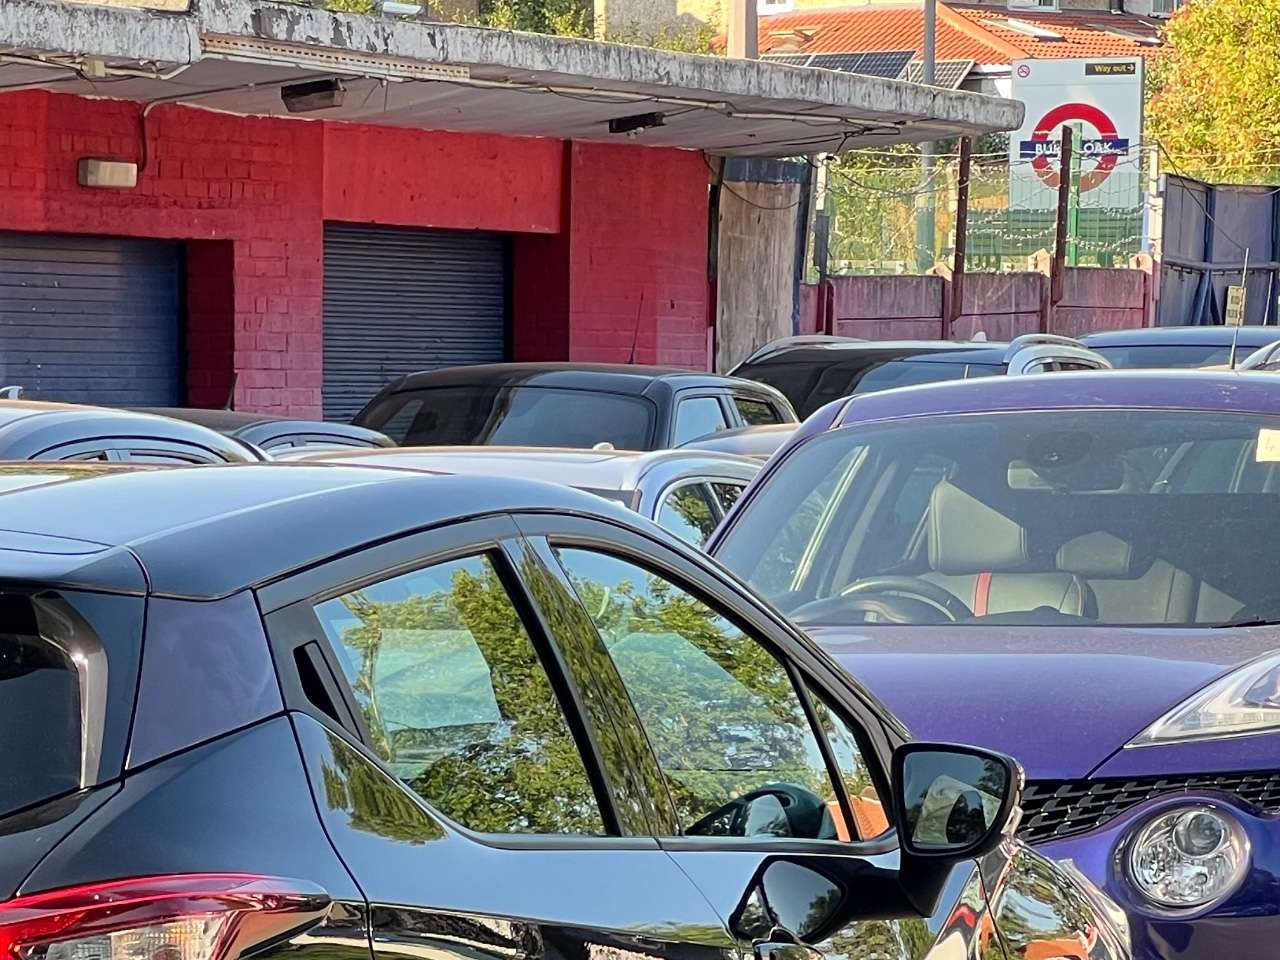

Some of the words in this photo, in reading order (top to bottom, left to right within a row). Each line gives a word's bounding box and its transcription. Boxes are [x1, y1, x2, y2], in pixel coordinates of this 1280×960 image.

[1094, 64, 1112, 74] Way
[1112, 64, 1127, 72] out
[1084, 142, 1113, 153] OAK
